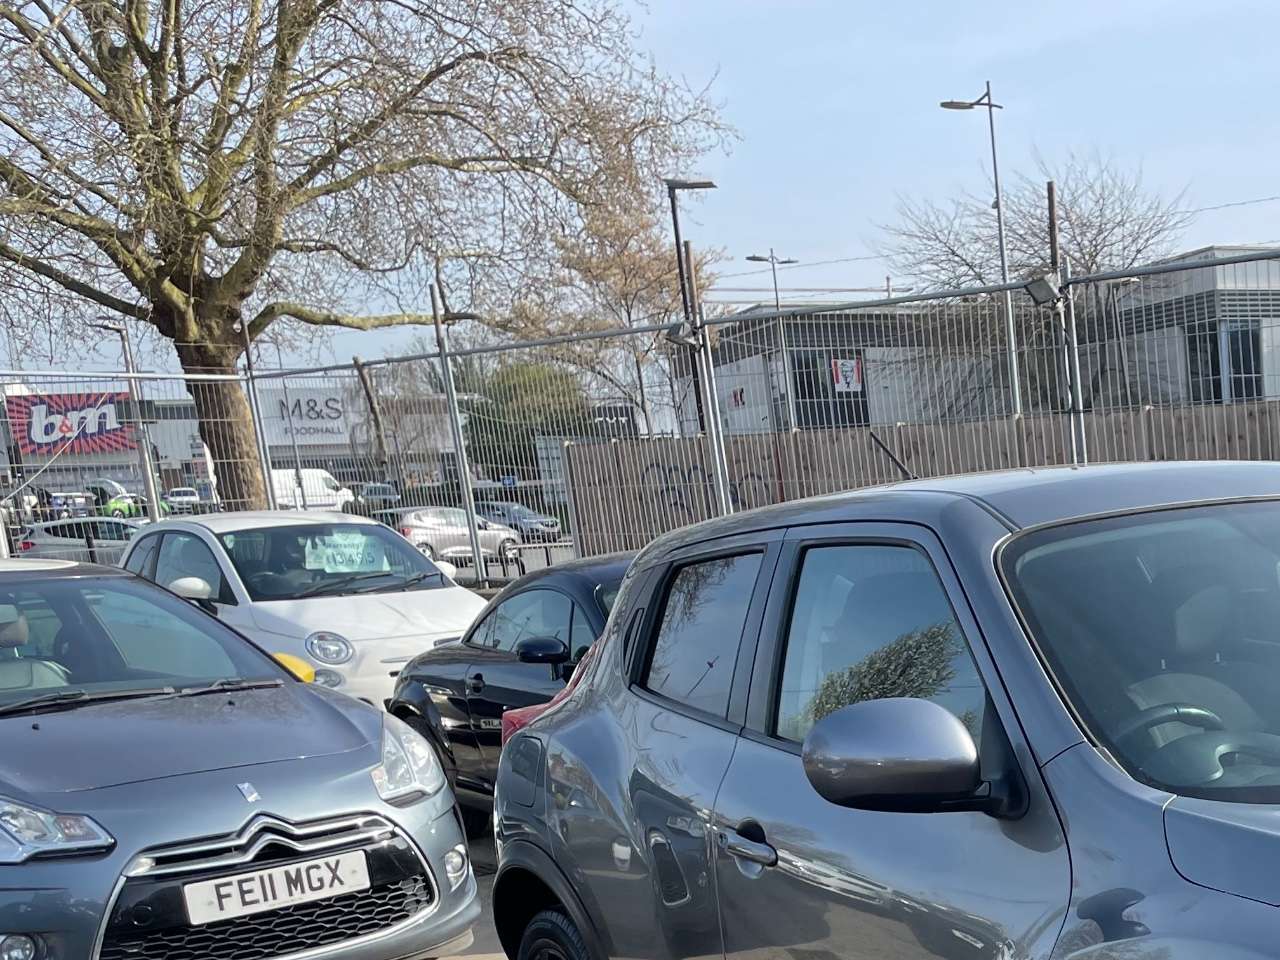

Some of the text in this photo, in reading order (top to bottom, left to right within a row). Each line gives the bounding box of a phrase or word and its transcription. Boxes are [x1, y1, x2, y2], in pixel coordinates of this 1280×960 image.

[30, 403, 122, 443] b&m
[279, 397, 342, 421] M&S
[213, 859, 345, 911] FE11 MGX
